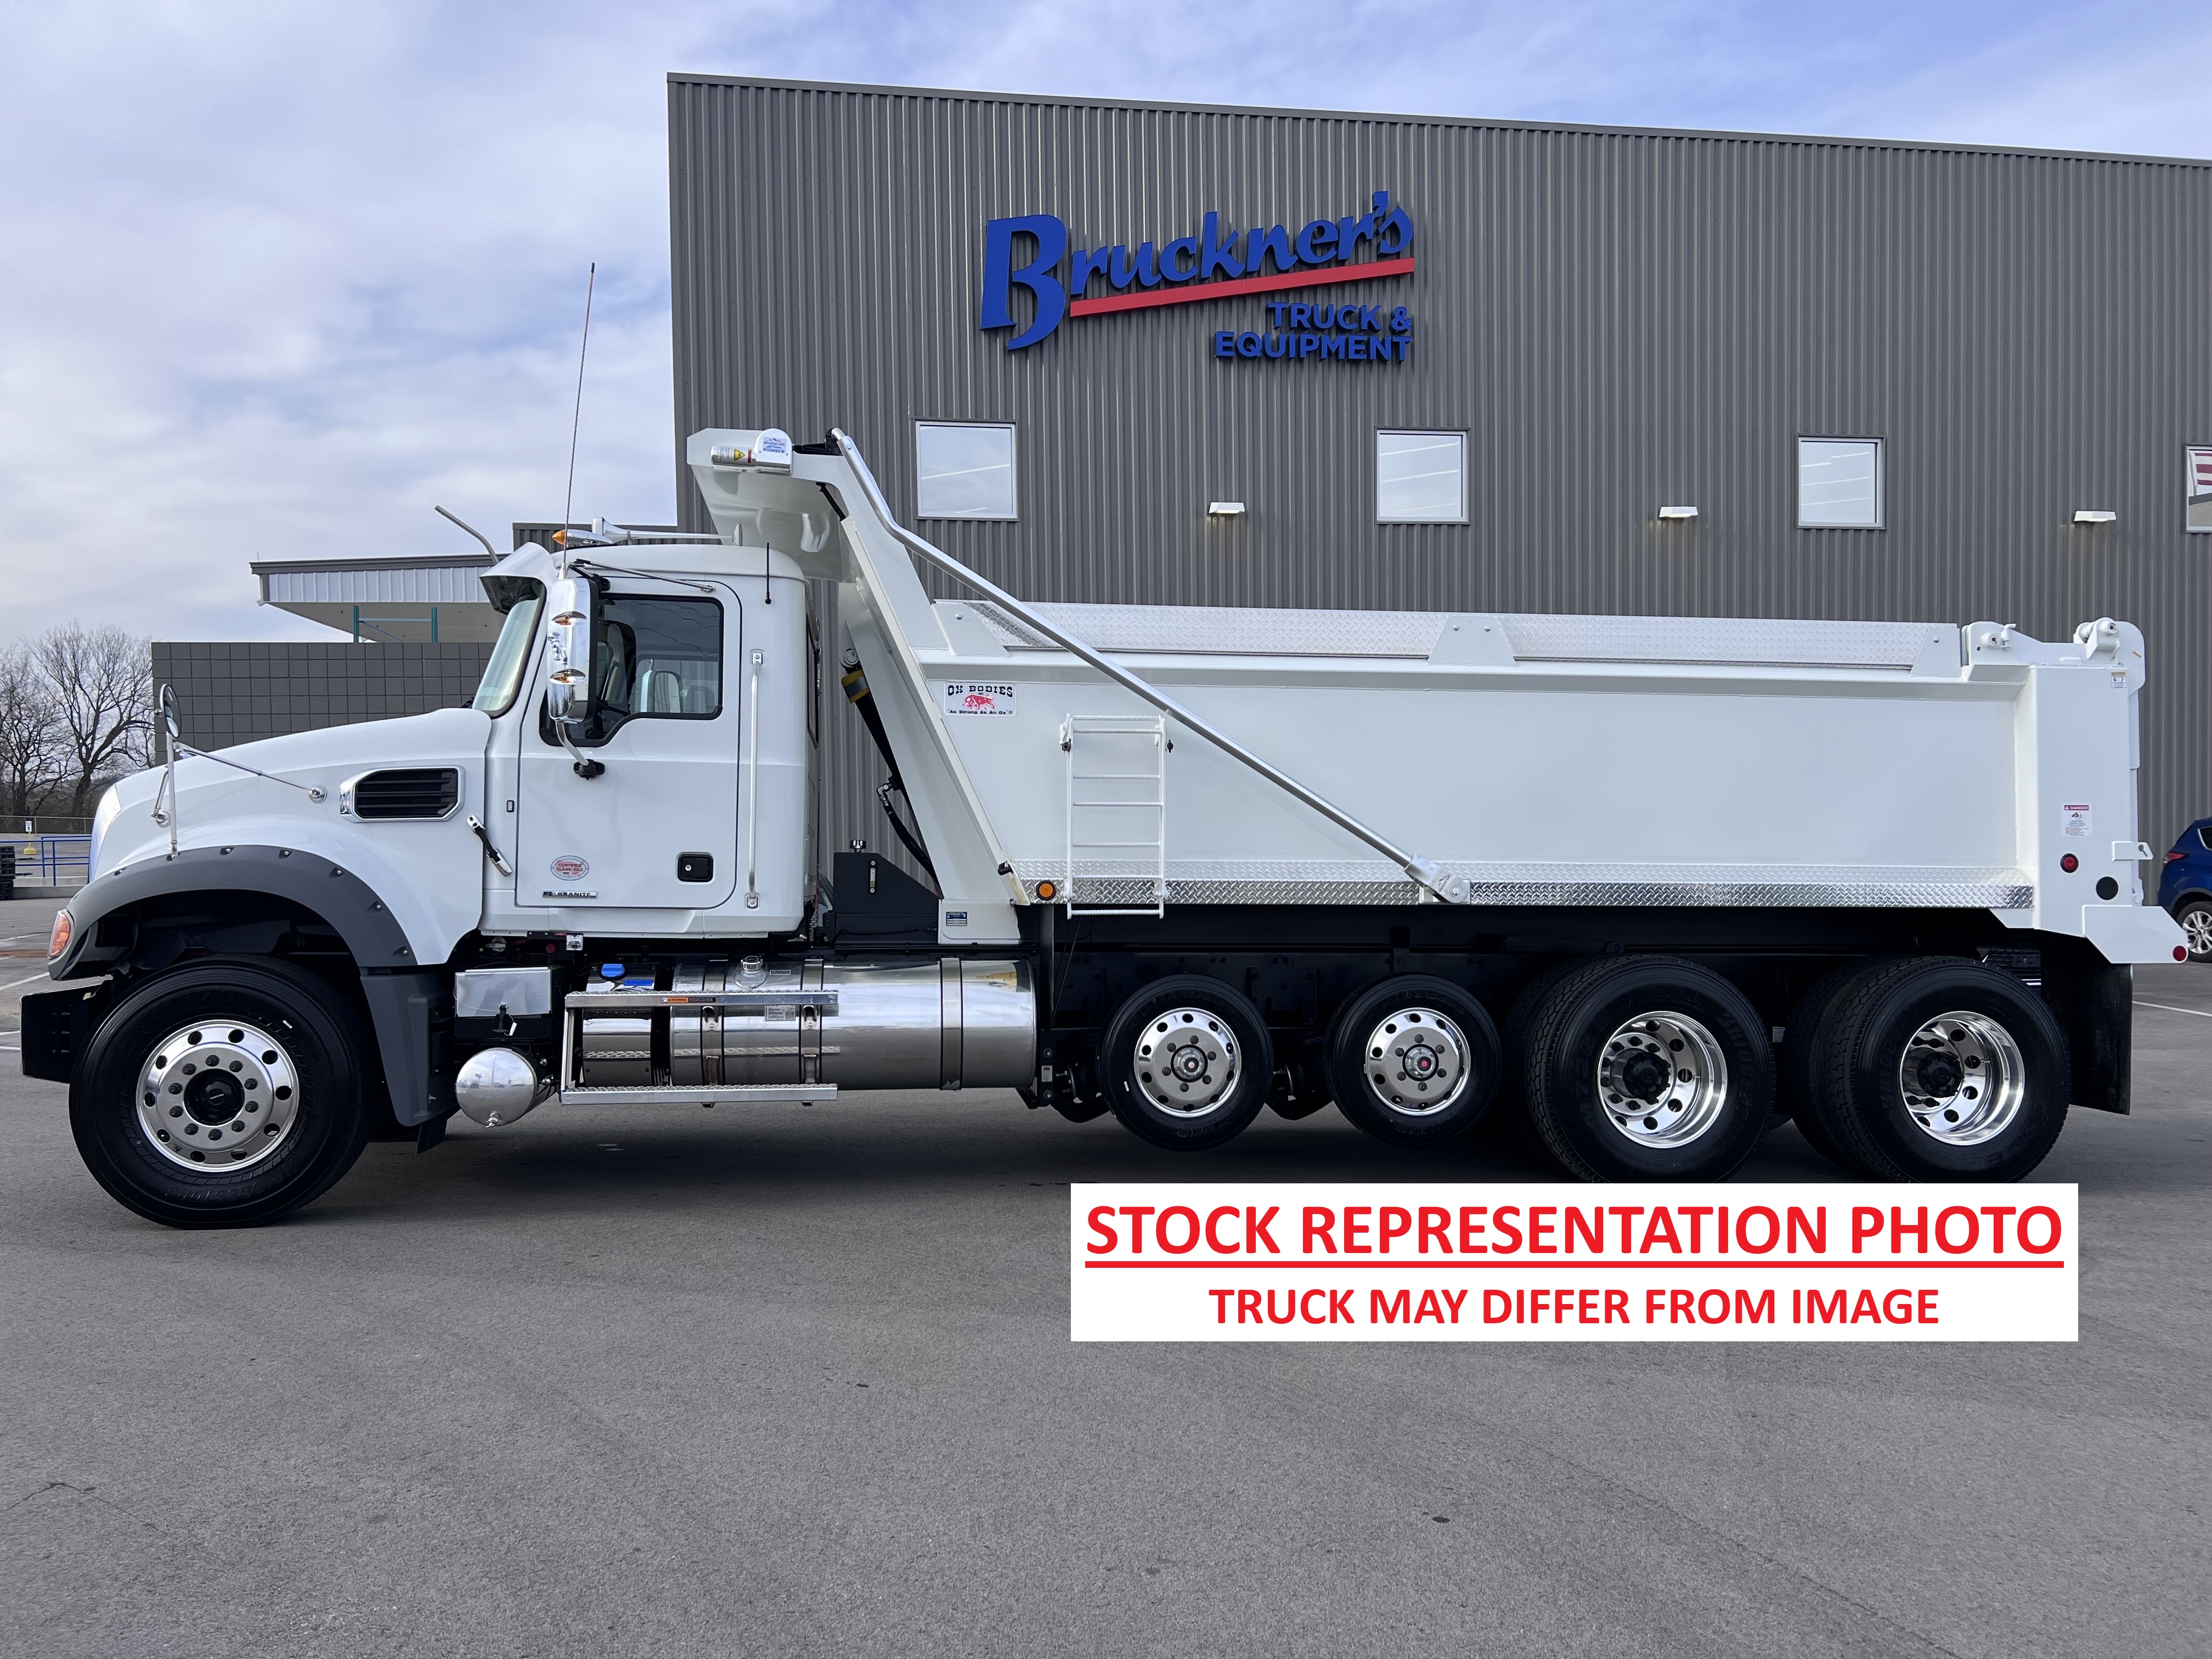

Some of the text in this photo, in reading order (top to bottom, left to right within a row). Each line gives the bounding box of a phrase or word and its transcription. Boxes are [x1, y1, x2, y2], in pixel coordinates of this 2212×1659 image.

[980, 191, 1414, 352] Bruckner's
[1267, 302, 1412, 331] TRUCK &
[1215, 331, 1413, 362] EQUIPMENT
[947, 685, 1013, 698] OX BODIES
